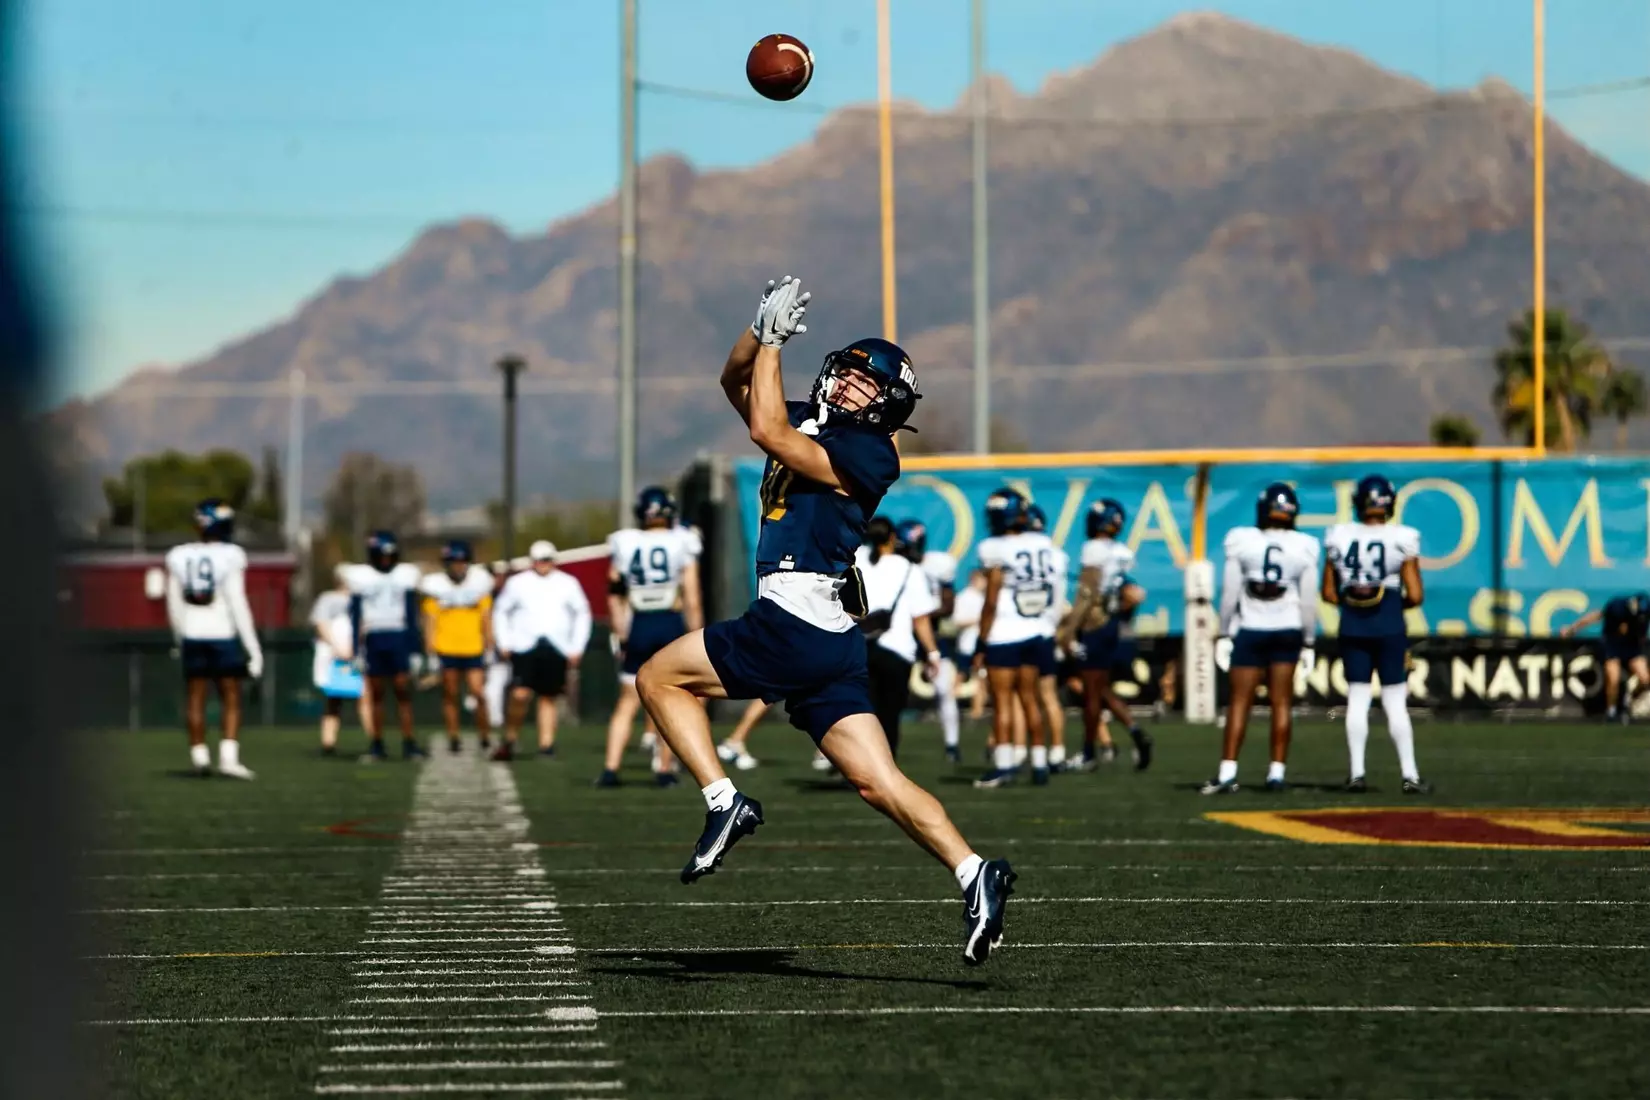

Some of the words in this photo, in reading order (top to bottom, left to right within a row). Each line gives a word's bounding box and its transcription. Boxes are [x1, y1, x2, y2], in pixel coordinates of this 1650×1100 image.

[1272, 476, 1650, 570] HOM
[184, 556, 216, 594] 19
[628, 547, 670, 585] 49
[1262, 545, 1283, 583] 6
[1344, 539, 1386, 582] 43
[1451, 654, 1645, 700] NATIO
